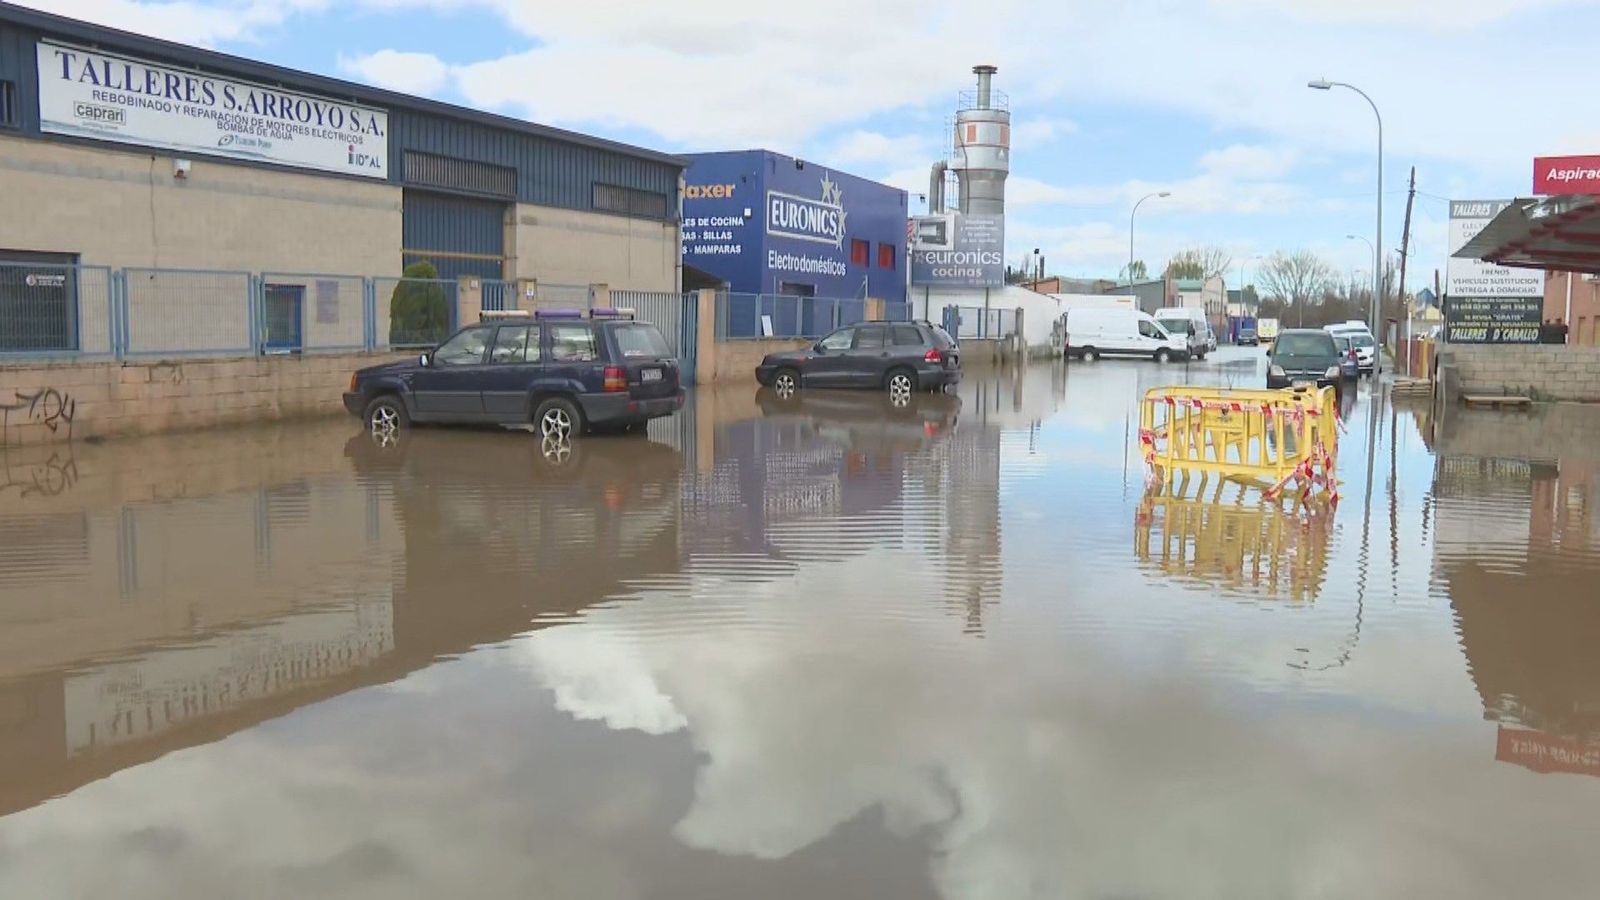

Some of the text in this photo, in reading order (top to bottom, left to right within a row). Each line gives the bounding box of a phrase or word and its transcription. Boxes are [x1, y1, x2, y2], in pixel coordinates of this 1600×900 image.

[55, 50, 384, 137] TALLERES S.ARROYO S.A.
[76, 104, 124, 122] caprari
[92, 90, 171, 113] REBOBINADO
[173, 104, 182, 114] Y
[183, 106, 248, 125] REPARACIÓN
[251, 118, 264, 127] DE
[266, 120, 310, 136] MOTORES
[217, 120, 293, 141] BOMBAS DE AGUA
[1453, 203, 1491, 217] TALLERES
[698, 218, 709, 226] DE
[710, 216, 744, 227] COCINA
[772, 200, 837, 236] EURONICS
[703, 230, 733, 240] SILLAS
[694, 244, 742, 255] MAMPARAS
[925, 248, 1001, 265] euronics
[768, 250, 846, 277] Electrodomésticos
[932, 265, 982, 277] cocinas
[1496, 286, 1537, 294] DOMICILIO
[1450, 328, 1488, 340] TALLERES
